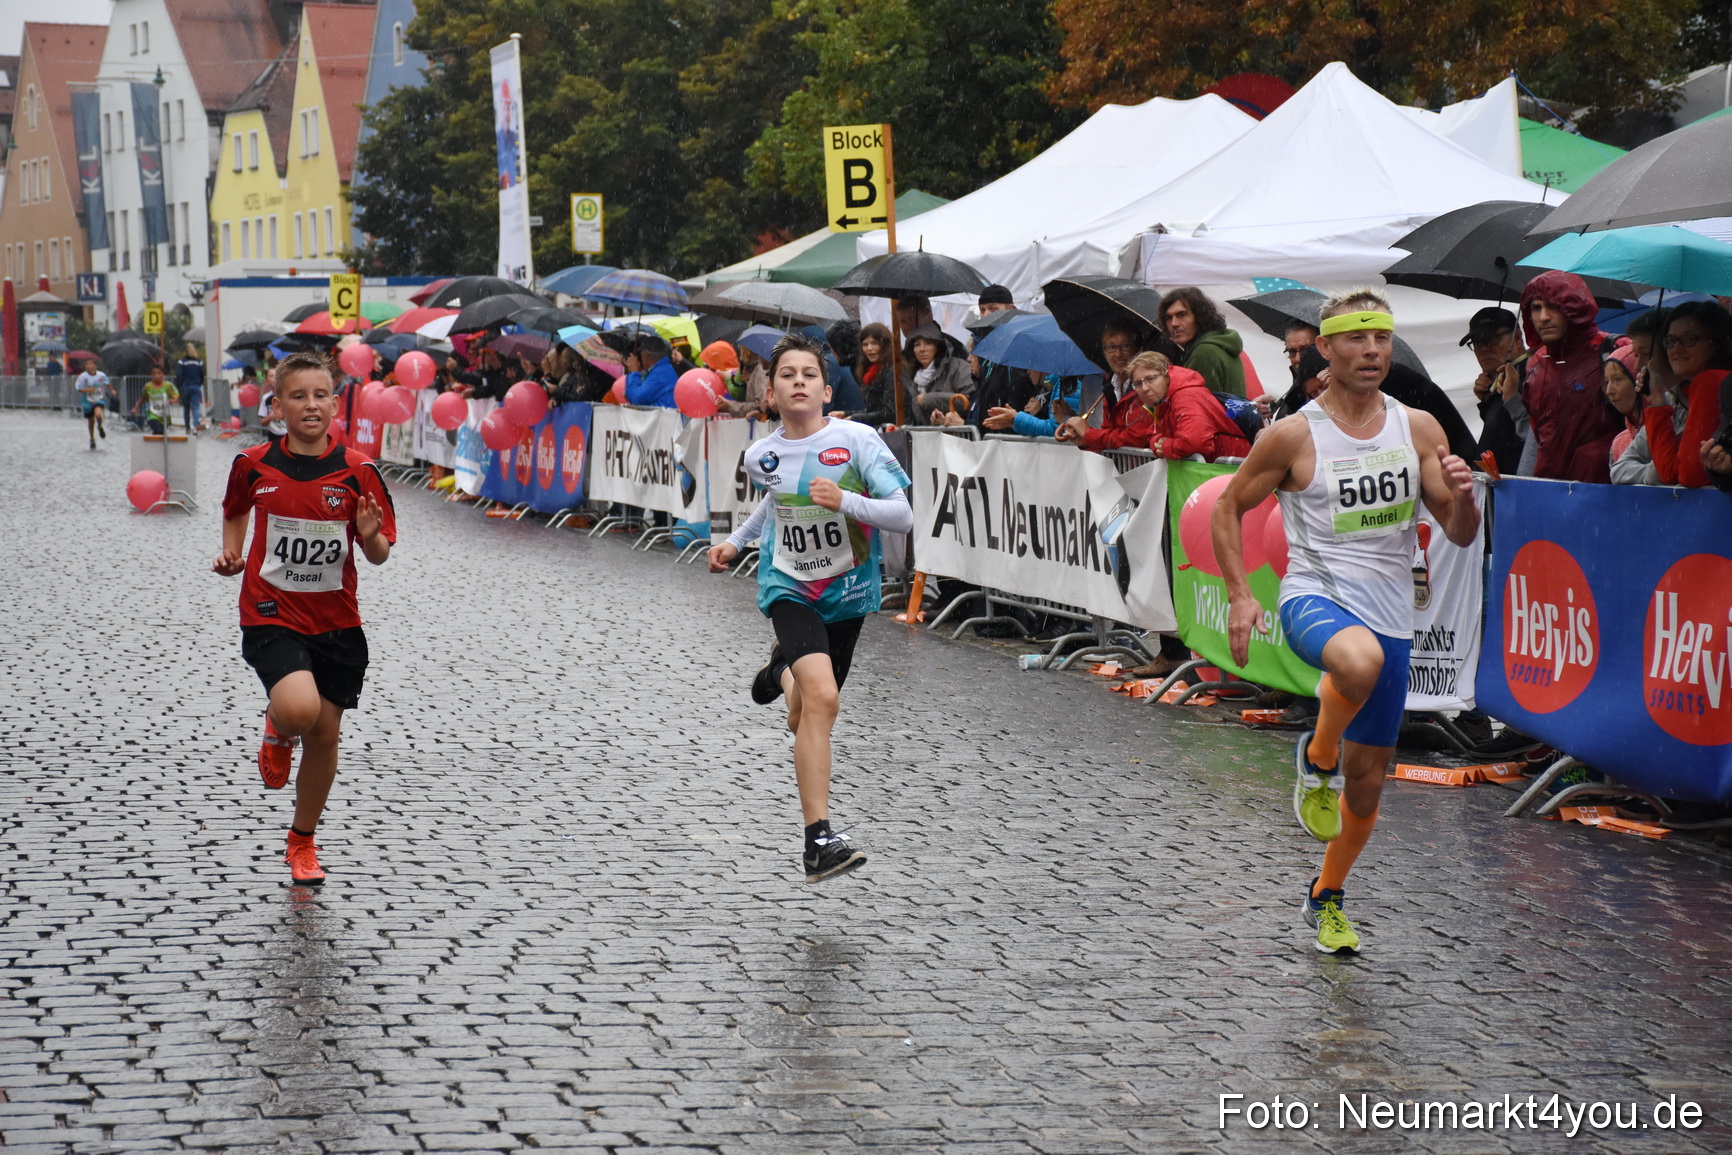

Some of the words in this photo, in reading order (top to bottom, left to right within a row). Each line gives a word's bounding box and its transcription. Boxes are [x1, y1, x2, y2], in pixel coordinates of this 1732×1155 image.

[832, 130, 884, 150] Block
[843, 158, 877, 208] B
[333, 275, 357, 284] Block
[337, 287, 353, 310] C
[149, 311, 159, 327] D
[1366, 449, 1407, 466] BOCK
[256, 486, 279, 495] saller
[1339, 467, 1410, 508] 5061
[304, 522, 342, 533] BOCK
[1361, 509, 1398, 527] Andrei
[782, 521, 842, 553] 4016
[274, 536, 342, 566] 4023
[793, 556, 833, 571] Jannick
[285, 570, 322, 582] Pascal
[1509, 573, 1594, 682] Hervis
[1510, 663, 1552, 687] SPORTS
[1650, 687, 1706, 716] SPORTS
[1404, 768, 1447, 782] WERBUNG
